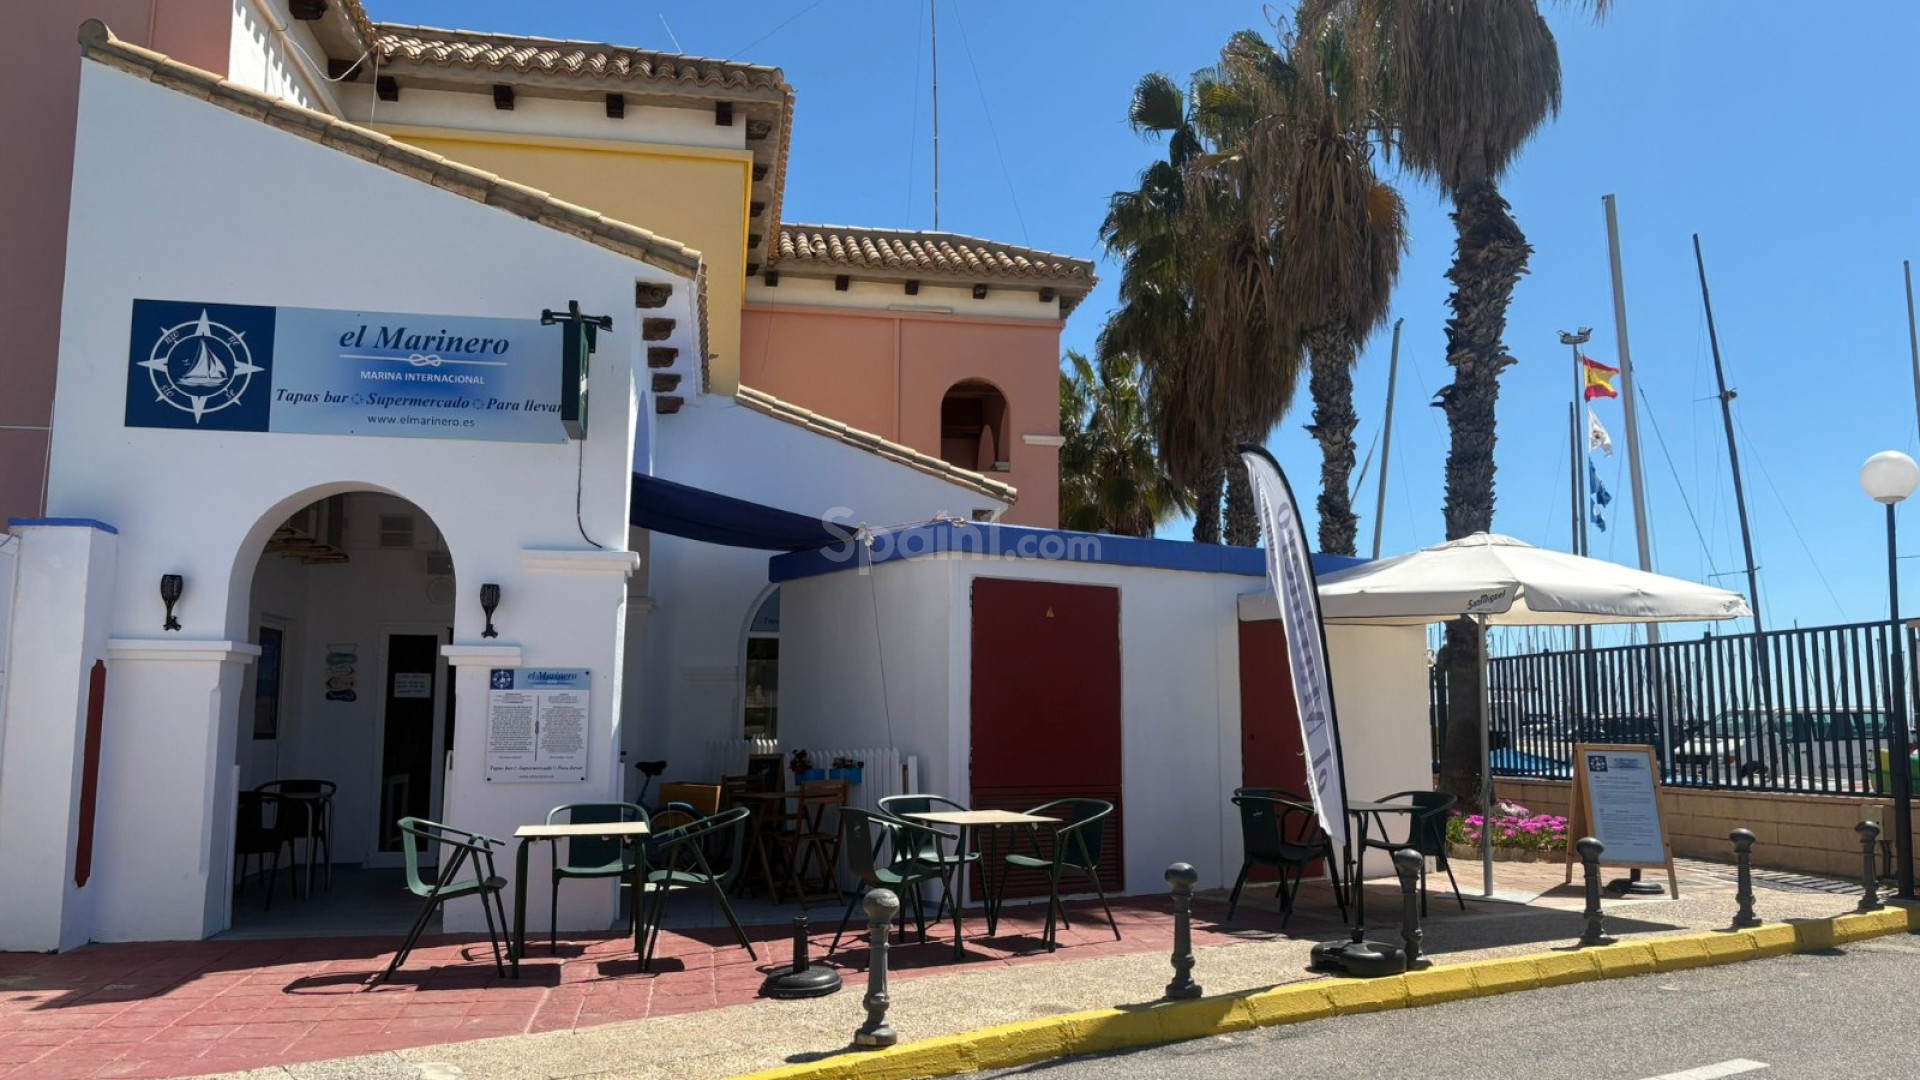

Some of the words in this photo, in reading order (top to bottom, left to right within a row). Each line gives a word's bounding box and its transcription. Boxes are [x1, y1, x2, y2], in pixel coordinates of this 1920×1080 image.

[338, 324, 368, 348] el
[373, 325, 510, 355] Marinero
[360, 370, 403, 381] MARINA
[405, 372, 486, 385] INTERNACIONAL
[276, 388, 320, 405] Tapas
[323, 390, 349, 404] bar
[366, 392, 470, 409] Supermercado
[486, 399, 519, 411] Para
[367, 414, 475, 427] www.elmarinero.es
